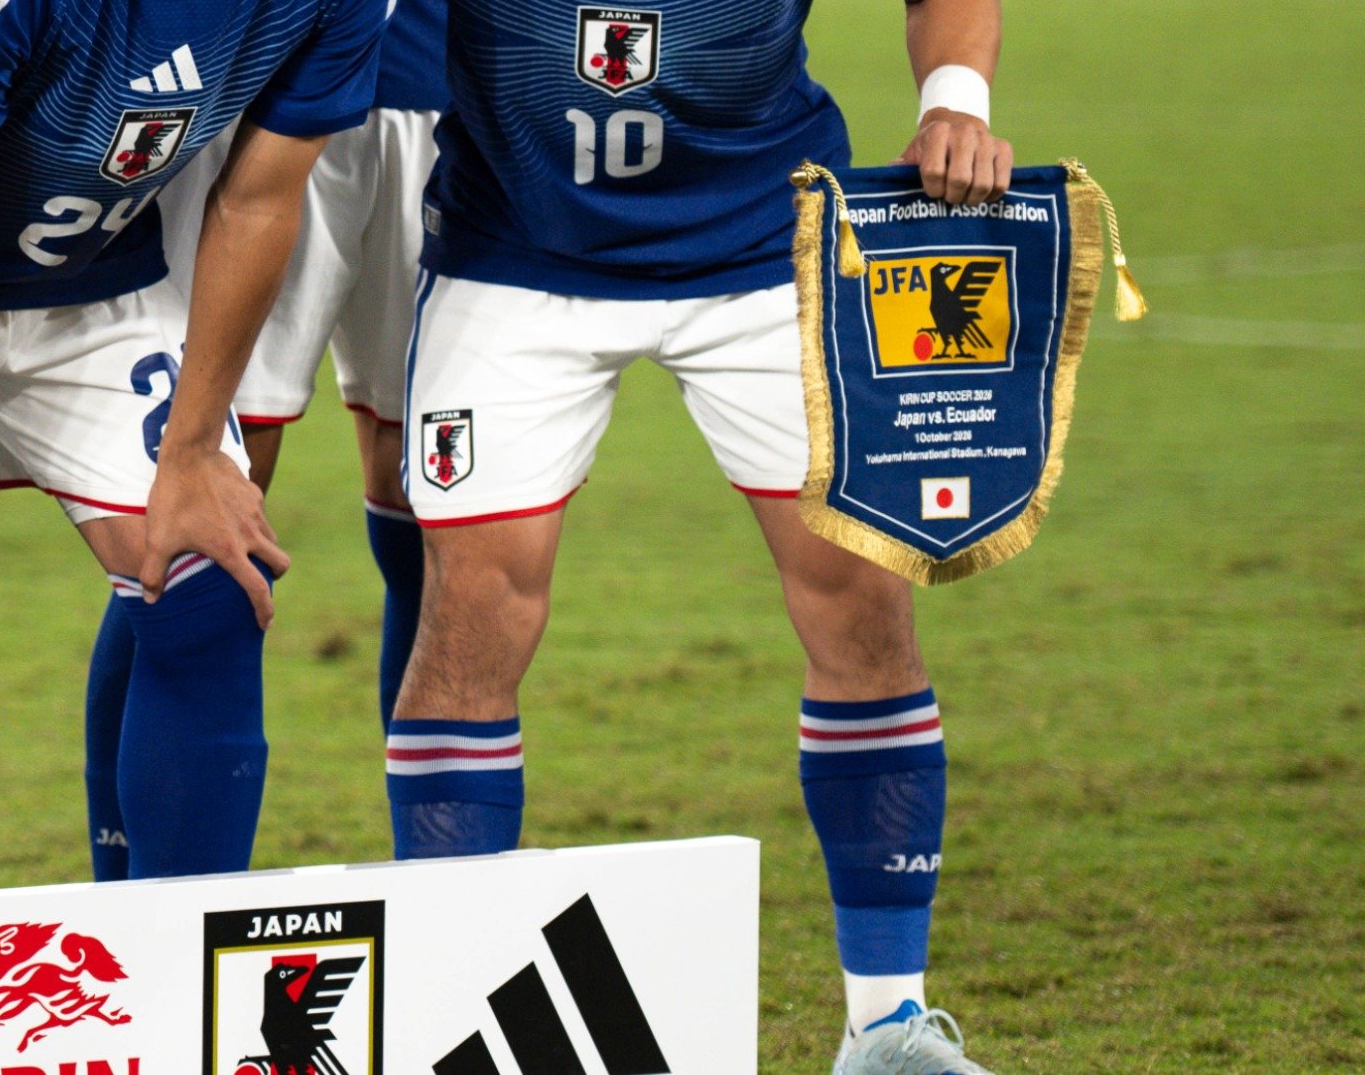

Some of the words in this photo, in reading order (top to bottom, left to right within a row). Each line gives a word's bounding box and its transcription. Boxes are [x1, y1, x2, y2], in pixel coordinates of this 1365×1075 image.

[598, 10, 642, 22] JAPAN
[566, 108, 664, 185] 10
[847, 206, 886, 226] apan
[889, 199, 947, 222] Football
[950, 201, 1049, 222] Association
[873, 265, 928, 295] JFA
[937, 390, 972, 403] SOCCER
[429, 411, 461, 422] JAPAN
[894, 410, 926, 430] Japan
[927, 411, 945, 424] vs.
[946, 406, 996, 423] Ecuador
[883, 854, 943, 874] JAP
[247, 911, 344, 938] JAPAN
